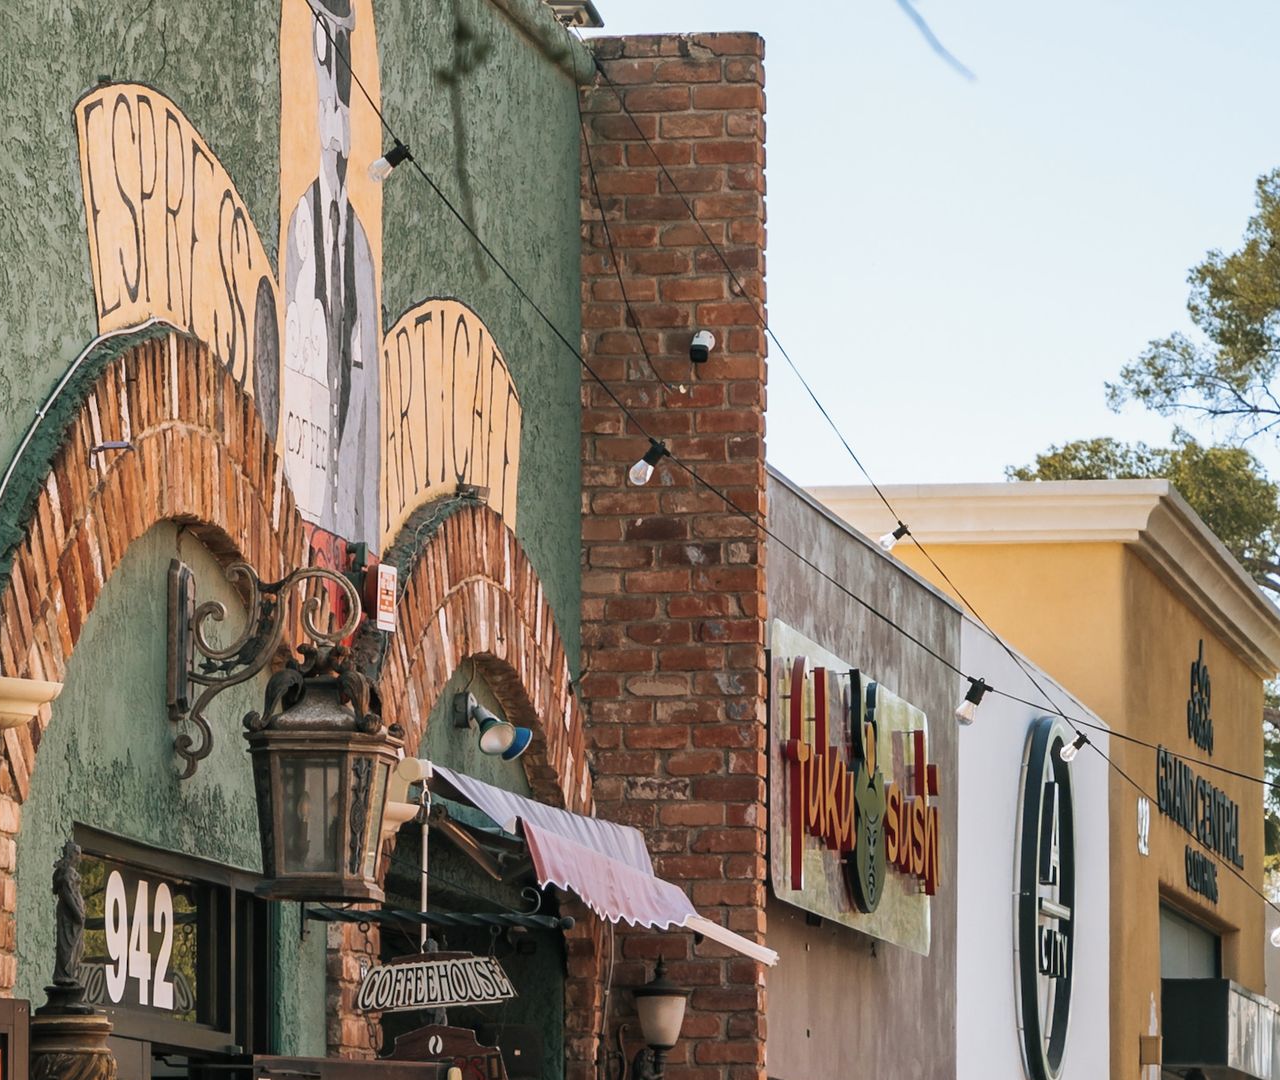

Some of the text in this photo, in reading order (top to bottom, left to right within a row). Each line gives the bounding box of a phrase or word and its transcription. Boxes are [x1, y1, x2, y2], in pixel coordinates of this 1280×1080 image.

[83, 91, 280, 446] ESPRESSO
[288, 410, 328, 471] COFFEE
[886, 730, 941, 896] sushi
[1156, 743, 1195, 834] GRAND
[1195, 775, 1245, 871] CENTRAL
[104, 870, 174, 1011] 942
[359, 957, 513, 1011] COFFEEHOUSE
[1038, 923, 1070, 979] CITY
